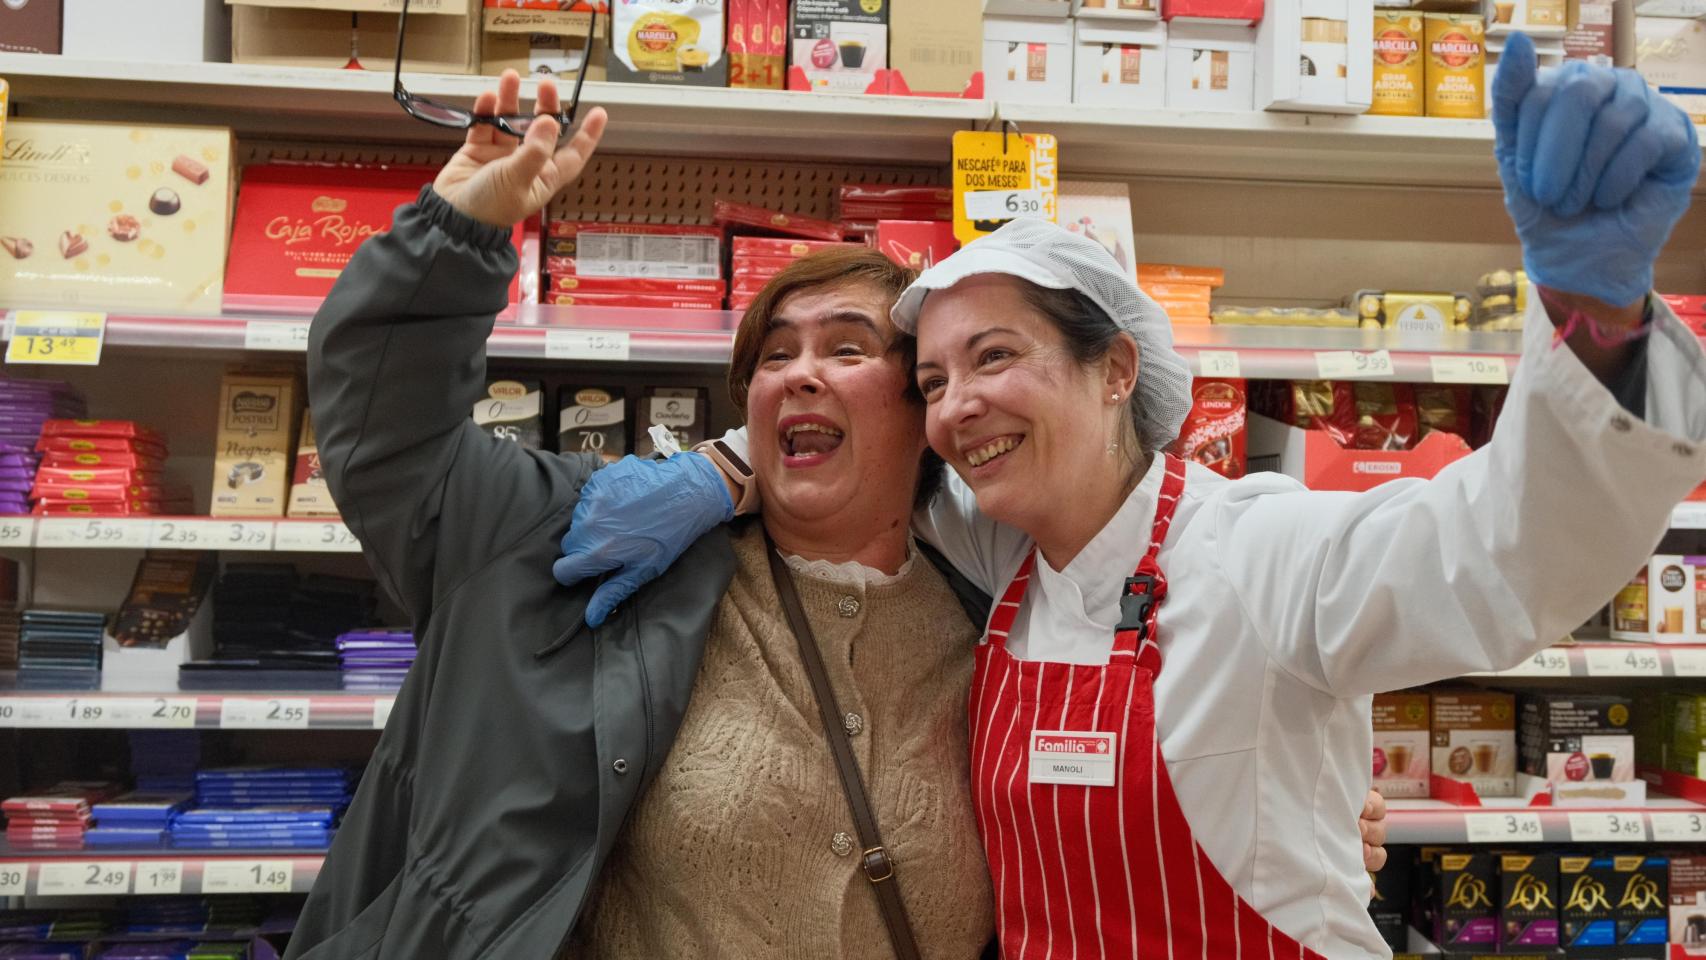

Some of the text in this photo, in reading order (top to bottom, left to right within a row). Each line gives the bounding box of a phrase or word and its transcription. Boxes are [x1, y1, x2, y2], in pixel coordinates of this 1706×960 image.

[1432, 42, 1479, 55] MARCILLA
[1374, 81, 1414, 91] AROMA
[1437, 83, 1476, 93] AROMA
[1003, 160, 1026, 173] PARA
[965, 174, 985, 187] DOS
[265, 215, 385, 246] Caja Roja
[1201, 401, 1232, 409] LINDOR
[229, 523, 266, 543] 3.79
[1624, 651, 1657, 669] 4.95
[67, 699, 102, 718] 1.89
[152, 698, 191, 719] 2.70
[266, 700, 304, 721] 2.55
[1038, 738, 1085, 753] Familia
[1052, 765, 1083, 774] MANOLI
[1505, 815, 1538, 833] 3.45
[1607, 815, 1640, 833] 3.45
[84, 865, 124, 886] 2.49
[250, 865, 287, 885] 1.49
